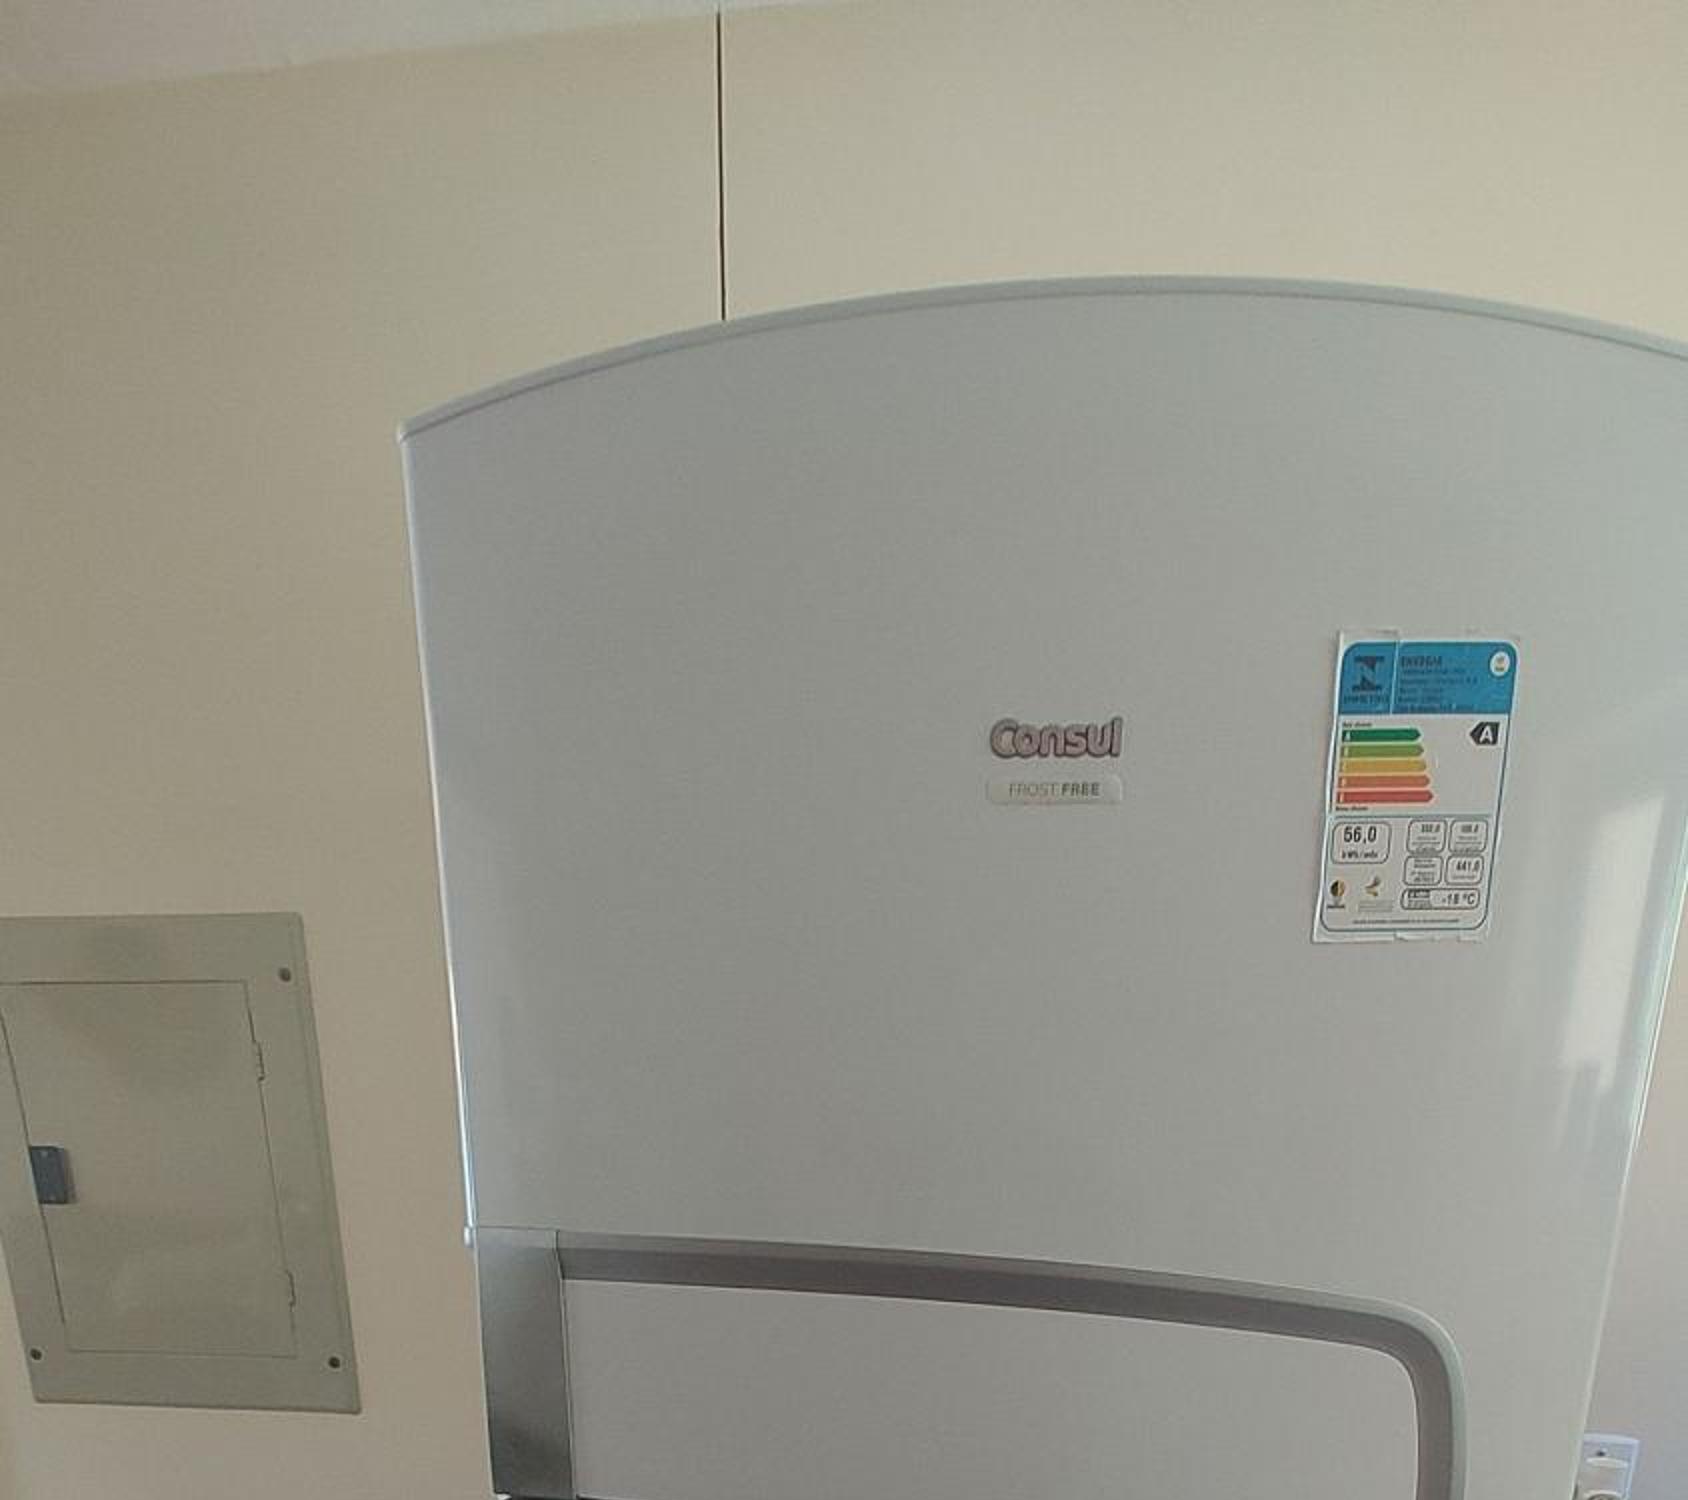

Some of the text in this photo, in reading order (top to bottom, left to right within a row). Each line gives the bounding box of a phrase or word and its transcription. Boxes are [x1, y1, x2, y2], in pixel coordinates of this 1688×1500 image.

[990, 716, 1123, 759] Consul
[1479, 725, 1494, 744] A
[1008, 781, 1101, 798] FROST FREE
